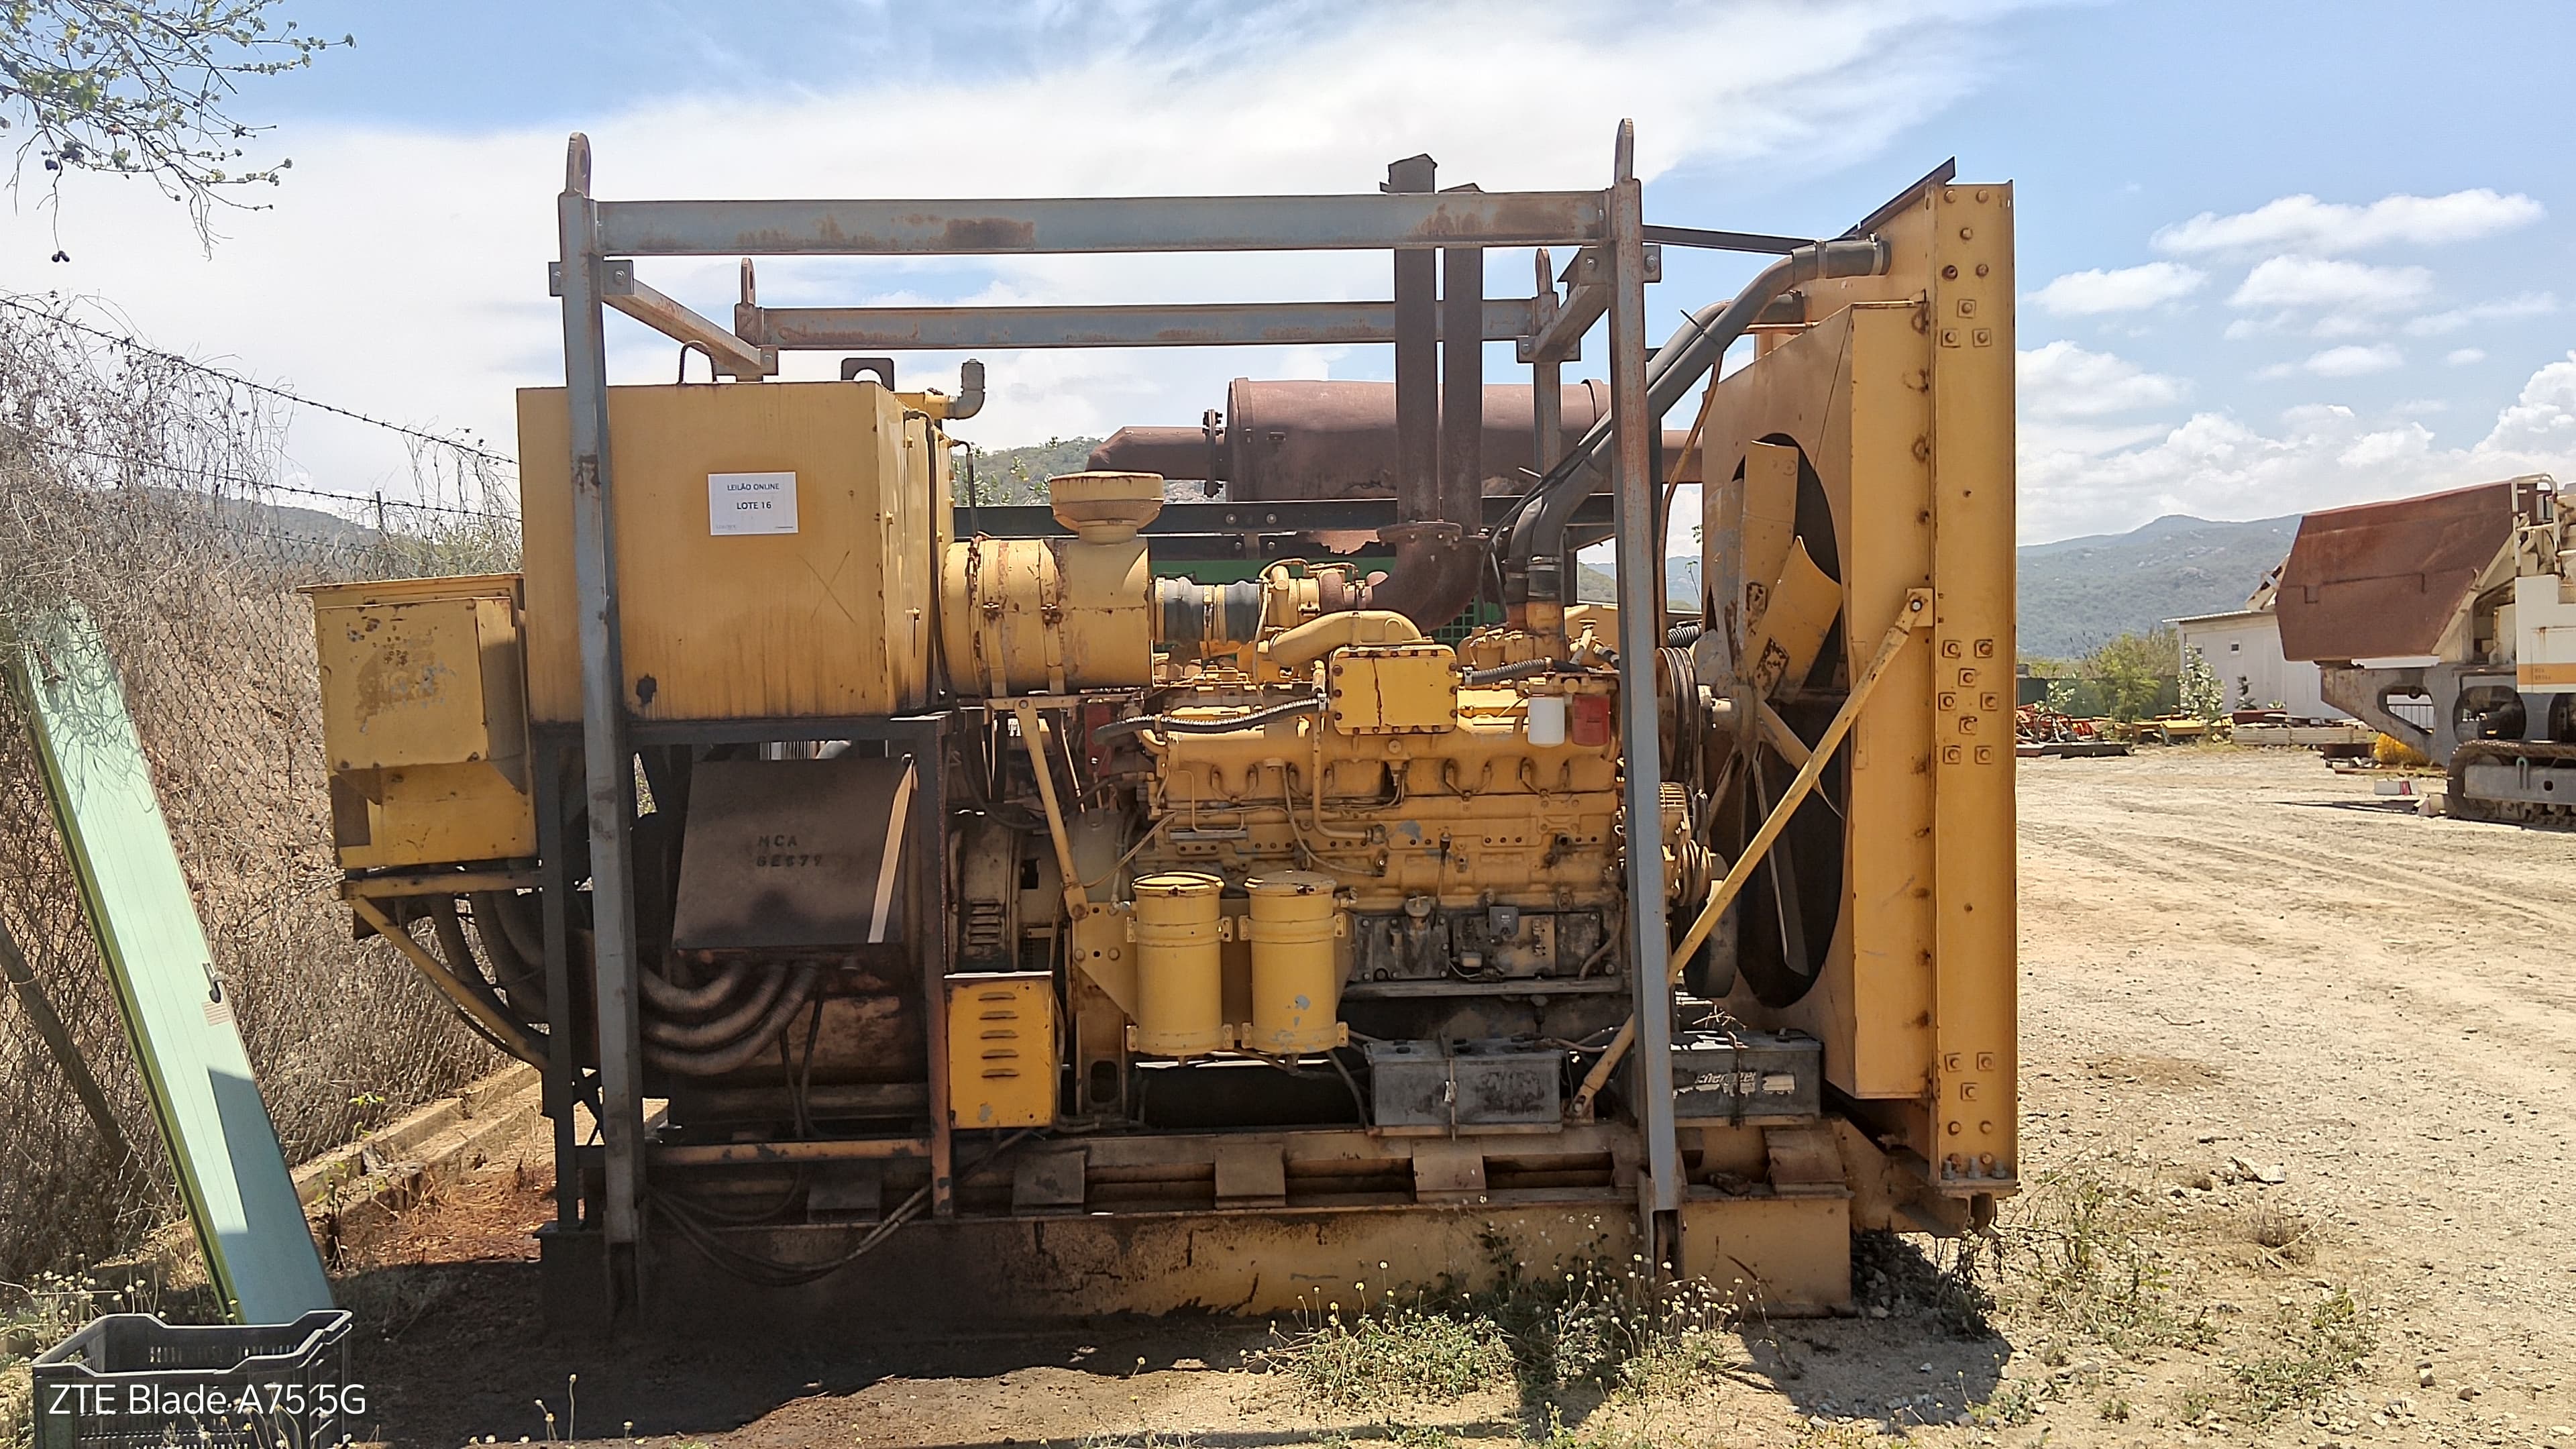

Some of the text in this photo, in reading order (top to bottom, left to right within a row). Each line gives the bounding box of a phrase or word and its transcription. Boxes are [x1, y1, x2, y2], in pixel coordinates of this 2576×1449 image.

[727, 482, 751, 491] LEILÃO
[737, 501, 771, 510] LOTE 16
[759, 835, 798, 847] MCA
